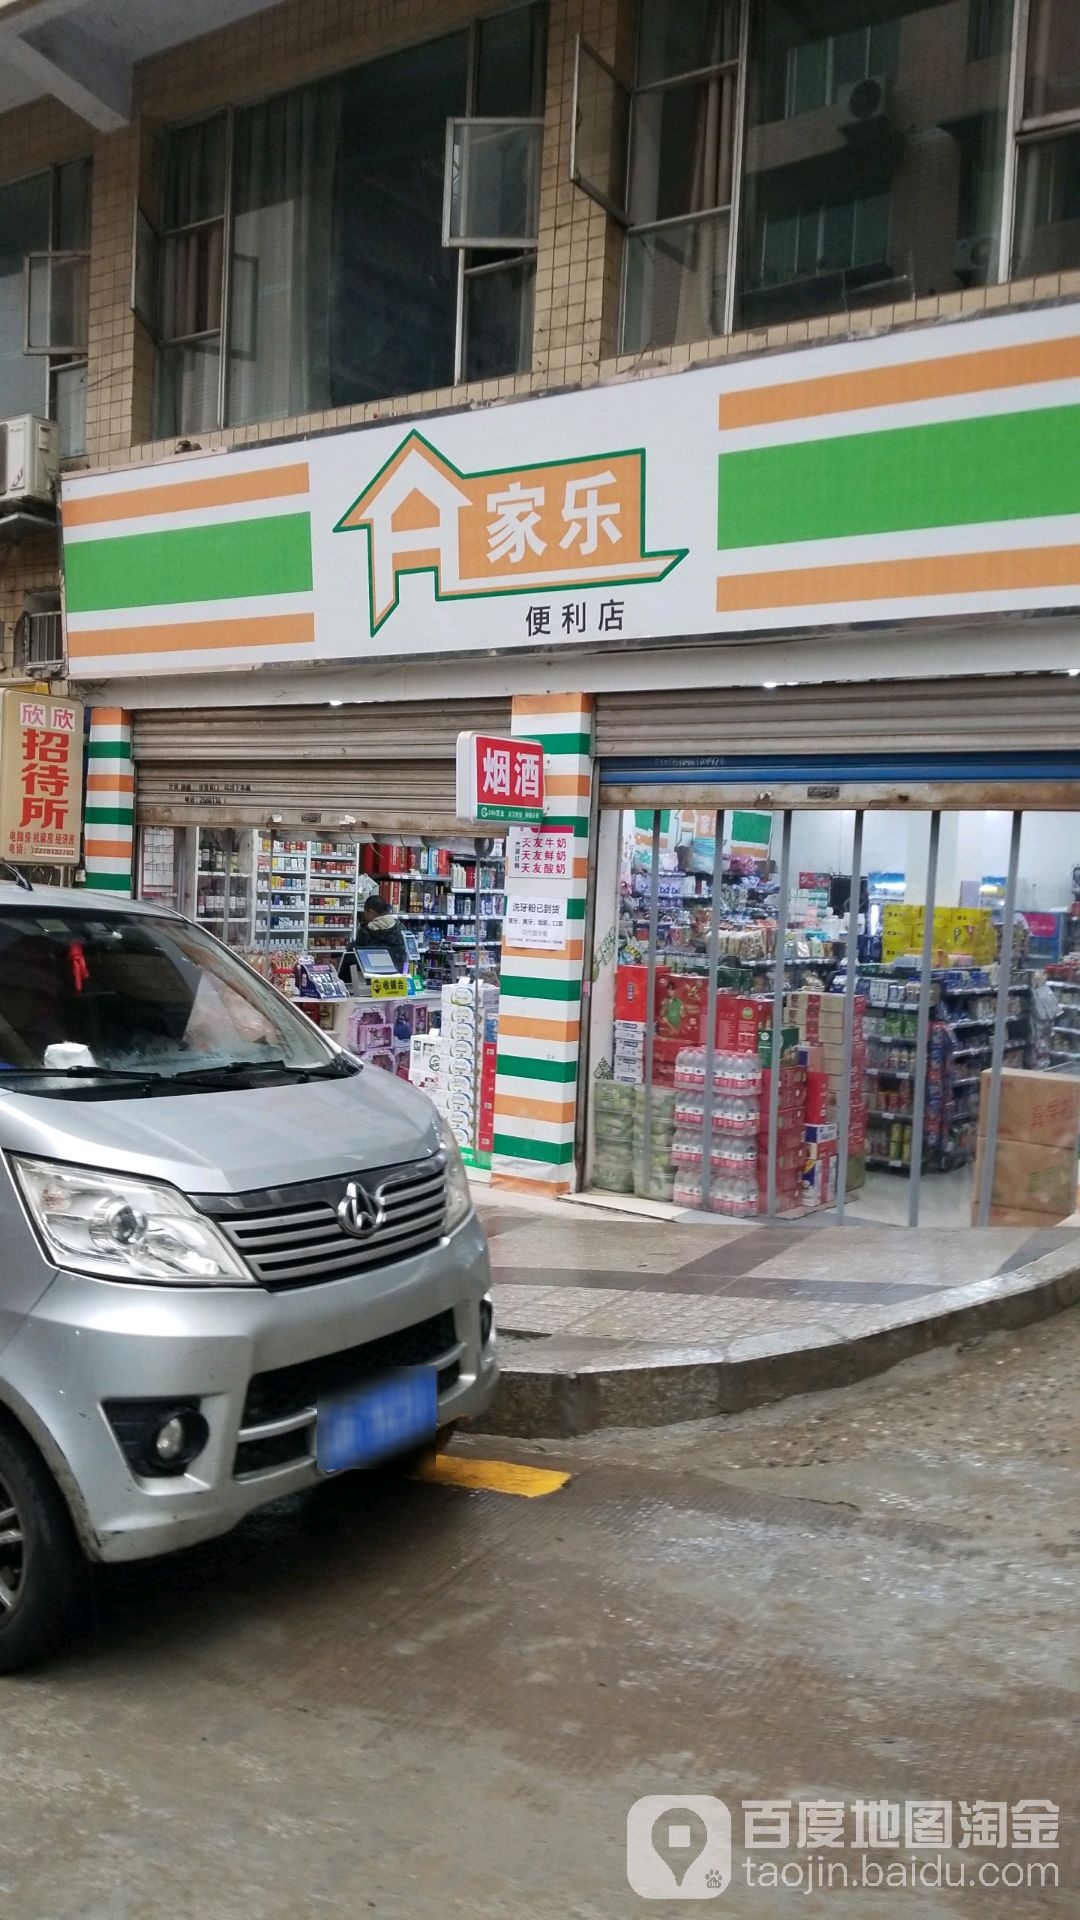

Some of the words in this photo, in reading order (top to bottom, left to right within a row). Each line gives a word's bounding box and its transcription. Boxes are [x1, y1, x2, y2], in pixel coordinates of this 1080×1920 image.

[486, 470, 623, 563] 家乐
[526, 599, 625, 636] 便利店
[22, 704, 73, 730] 欣欣
[19, 728, 69, 829] 招待所
[482, 747, 539, 798] 烟酒
[521, 850, 566, 861] 天友鲜奶
[522, 838, 567, 849] 天友牛奶
[521, 863, 566, 875] 天友酸奶
[382, 979, 404, 990] 收银台
